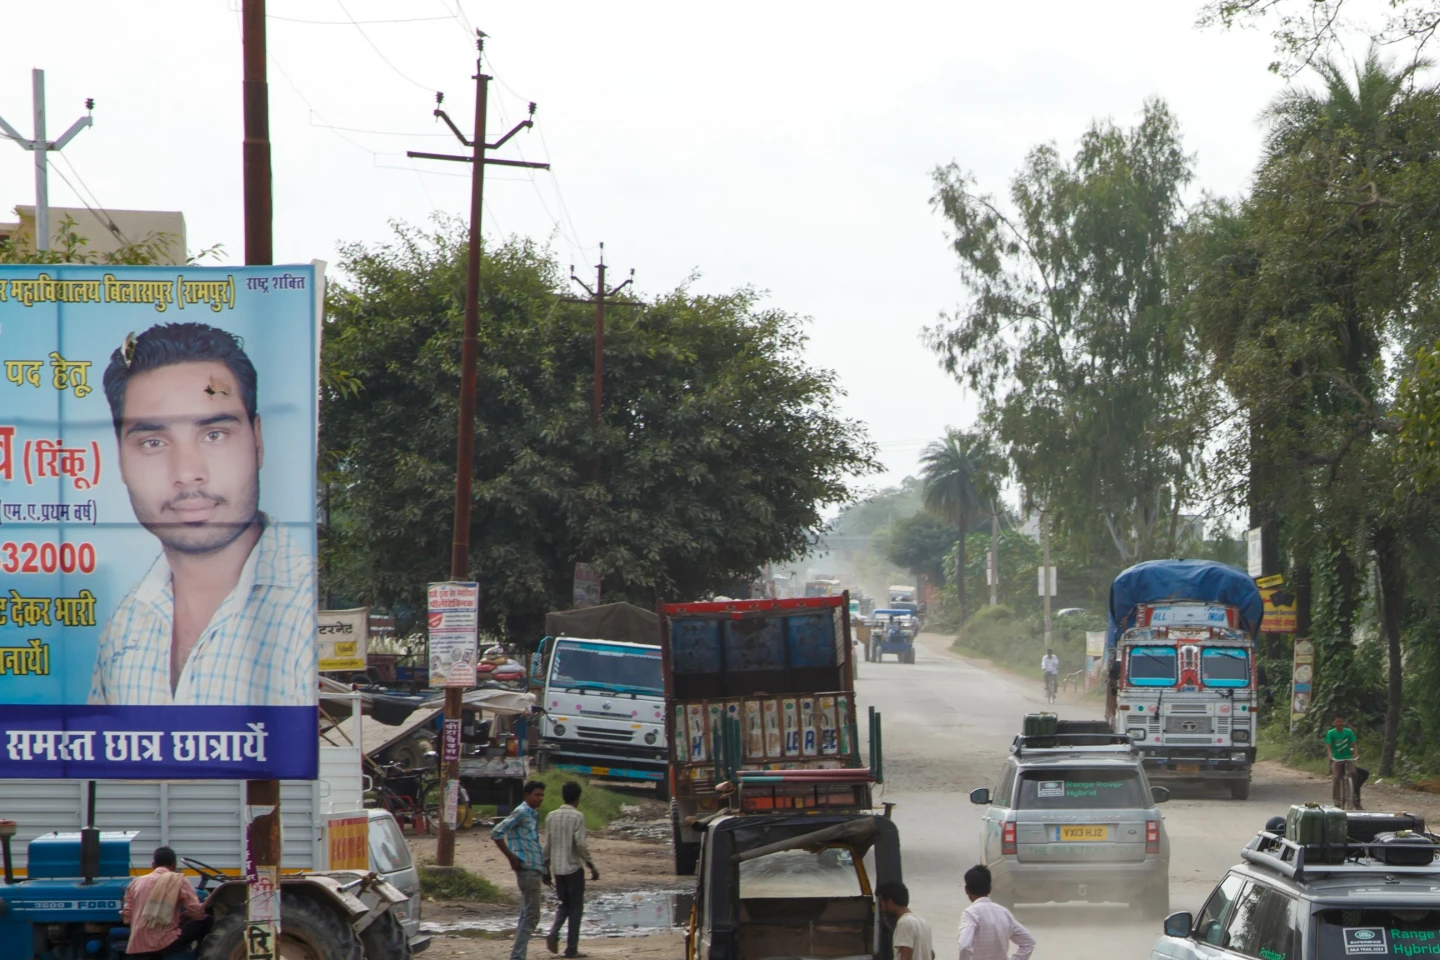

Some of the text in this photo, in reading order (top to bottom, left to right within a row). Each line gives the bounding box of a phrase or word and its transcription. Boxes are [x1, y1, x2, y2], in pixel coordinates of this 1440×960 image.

[10, 273, 100, 307] महाविद्यालय
[103, 273, 173, 312] बिलासपुर
[177, 274, 236, 312] (रामपुर)
[246, 273, 305, 293] राष्ट्र शक्ति
[5, 360, 43, 388] पद
[23, 439, 101, 490] (रिंकू)
[0, 542, 96, 574] 32000
[9, 590, 51, 627] देकर
[54, 590, 96, 627] भारी
[5, 722, 268, 762] समस्त छात्र छात्रायें
[1066, 781, 1094, 789] Range
[1066, 789, 1097, 797] Hybrid
[78, 901, 116, 909] FORD
[1391, 929, 1435, 941] Range
[1393, 944, 1440, 956] Hybrid
